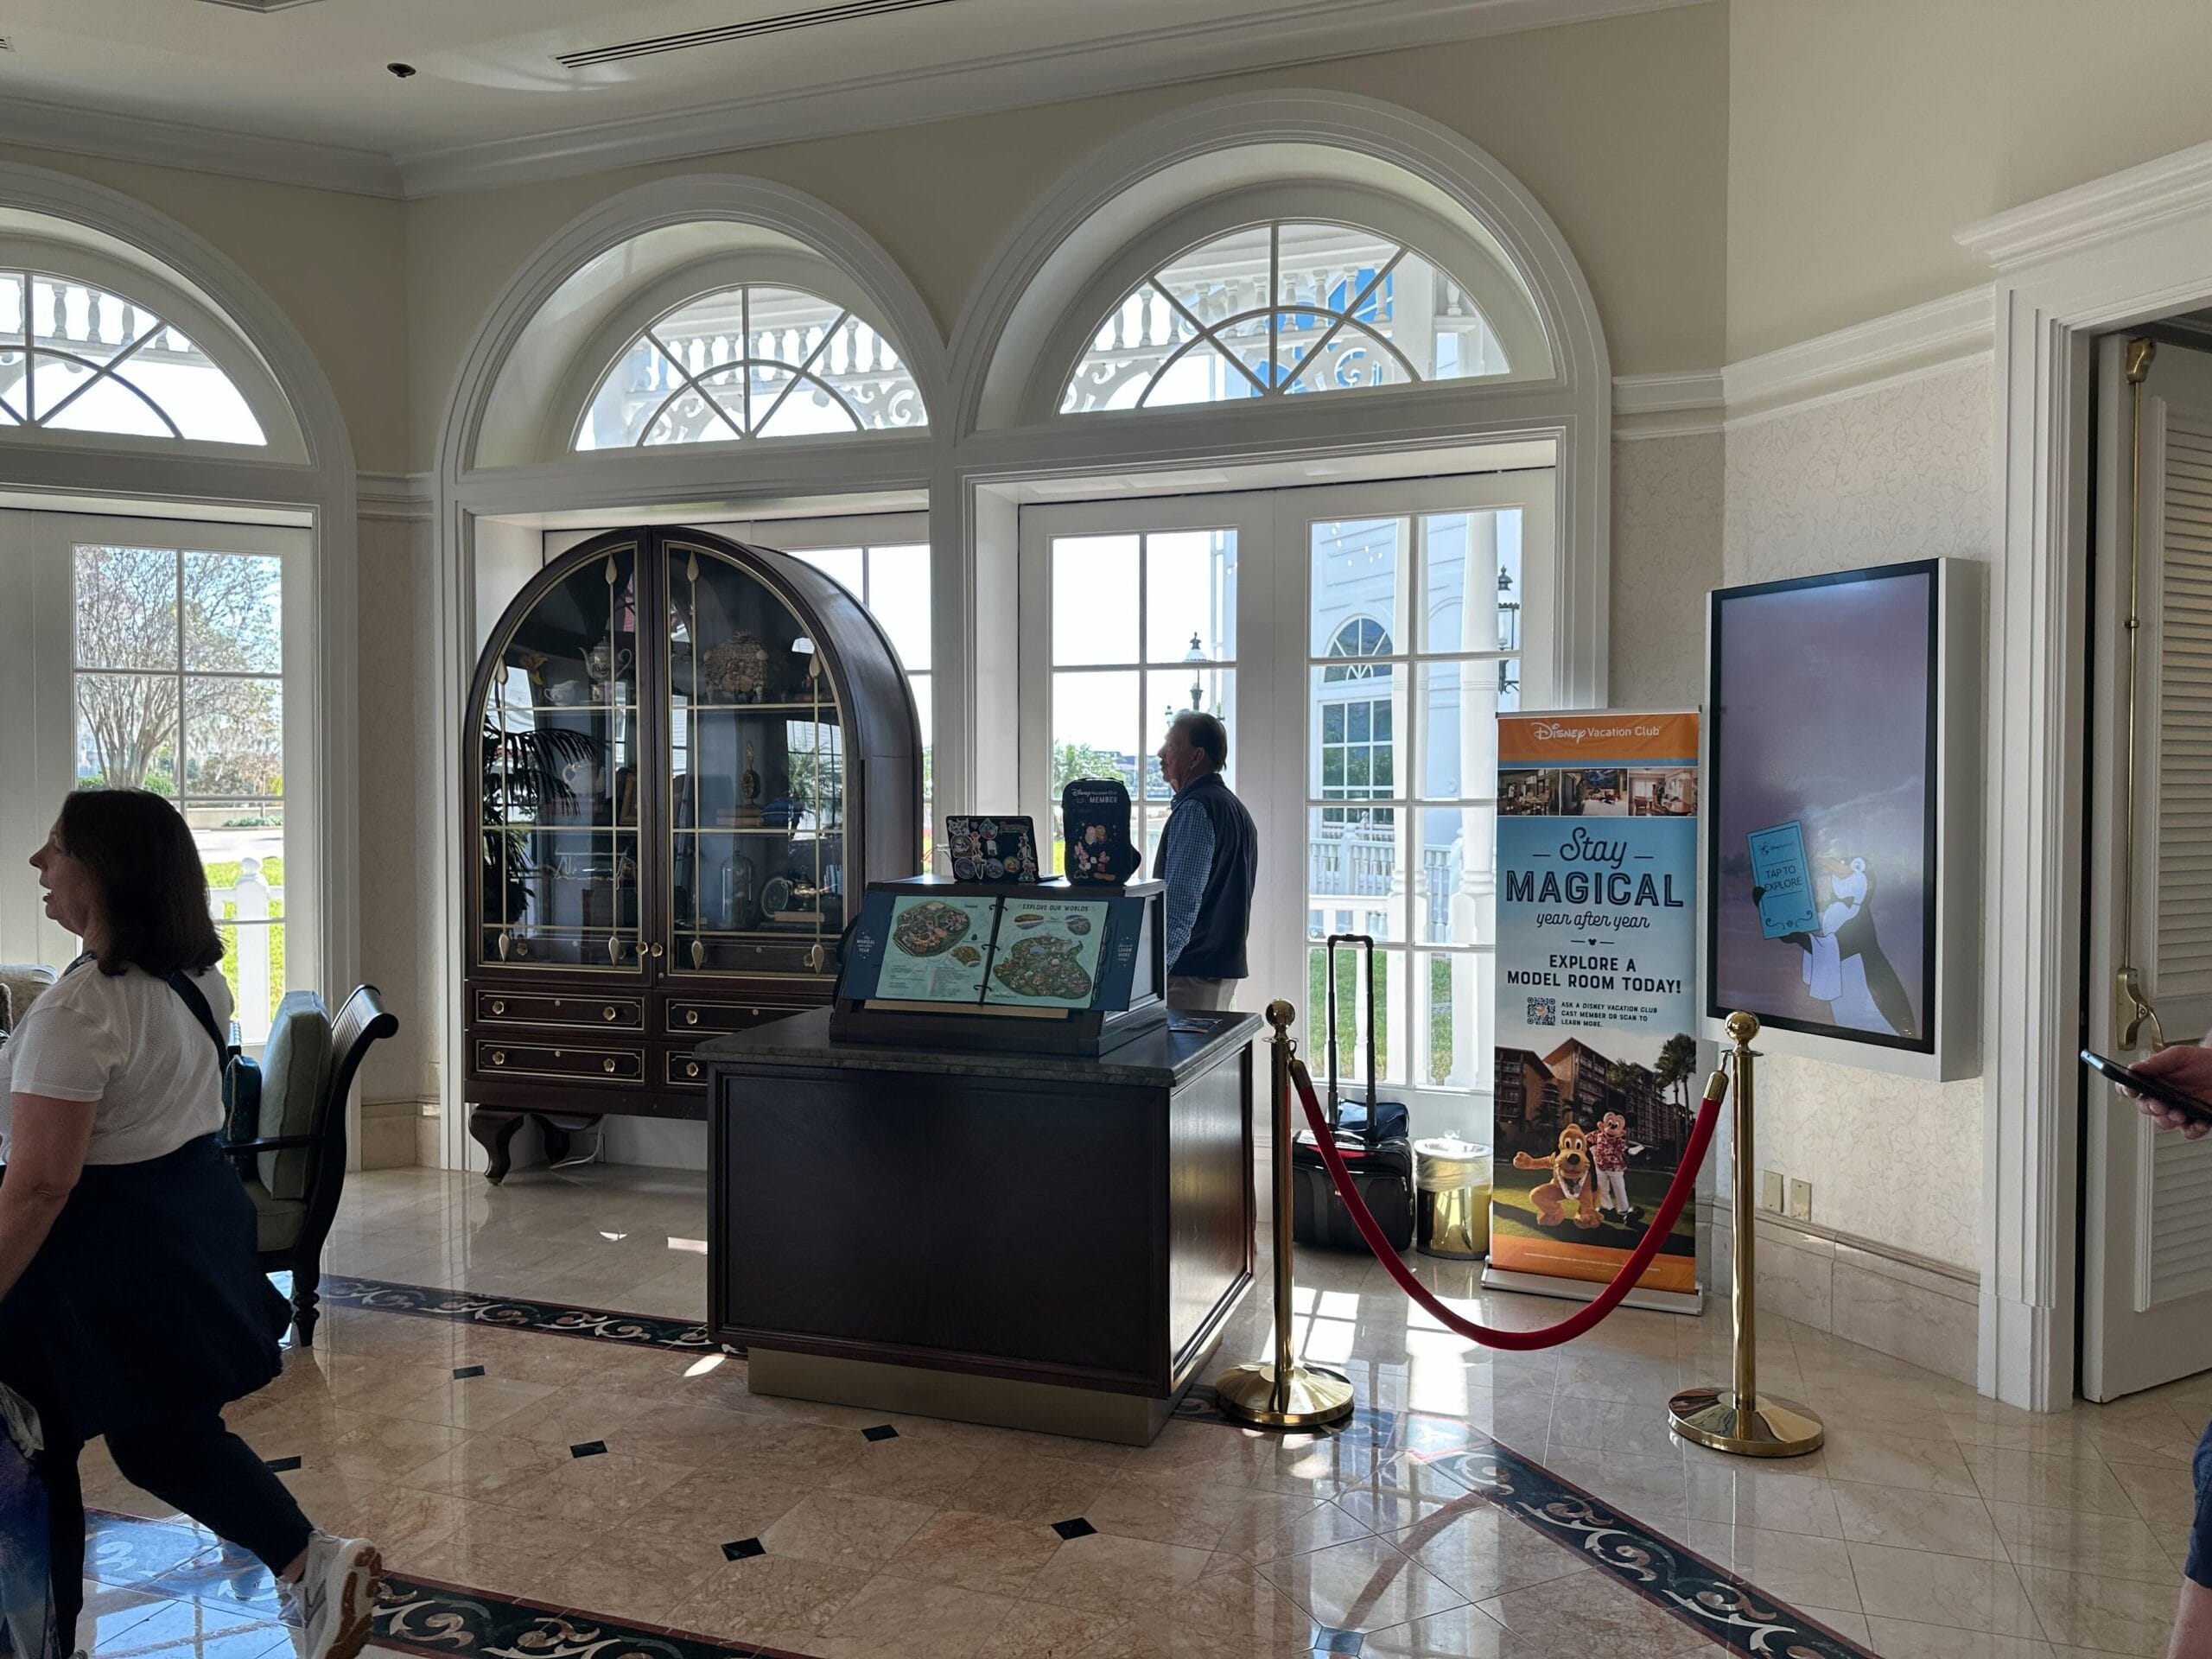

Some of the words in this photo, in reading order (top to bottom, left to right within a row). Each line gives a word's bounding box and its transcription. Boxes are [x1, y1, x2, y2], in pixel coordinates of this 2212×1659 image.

[1530, 721, 1586, 743] Disney
[1587, 726, 1631, 737] Vacation
[1634, 726, 1660, 736] Club
[1560, 826, 1628, 869] Stay
[1765, 868, 1782, 879] TAP
[1783, 865, 1796, 875] TO
[1506, 870, 1684, 907] MAGICAL
[1764, 876, 1802, 891] EXPLORE
[1536, 912, 1572, 927] year
[1574, 911, 1611, 930] after
[1613, 914, 1650, 931] year
[1549, 954, 1618, 971] EXPLORE
[1625, 958, 1637, 972] A
[1507, 970, 1561, 987] MODEL
[1567, 974, 1614, 990] ROOM
[1622, 976, 1681, 994] TODAY!
[1607, 1004, 1638, 1013] VACATION
